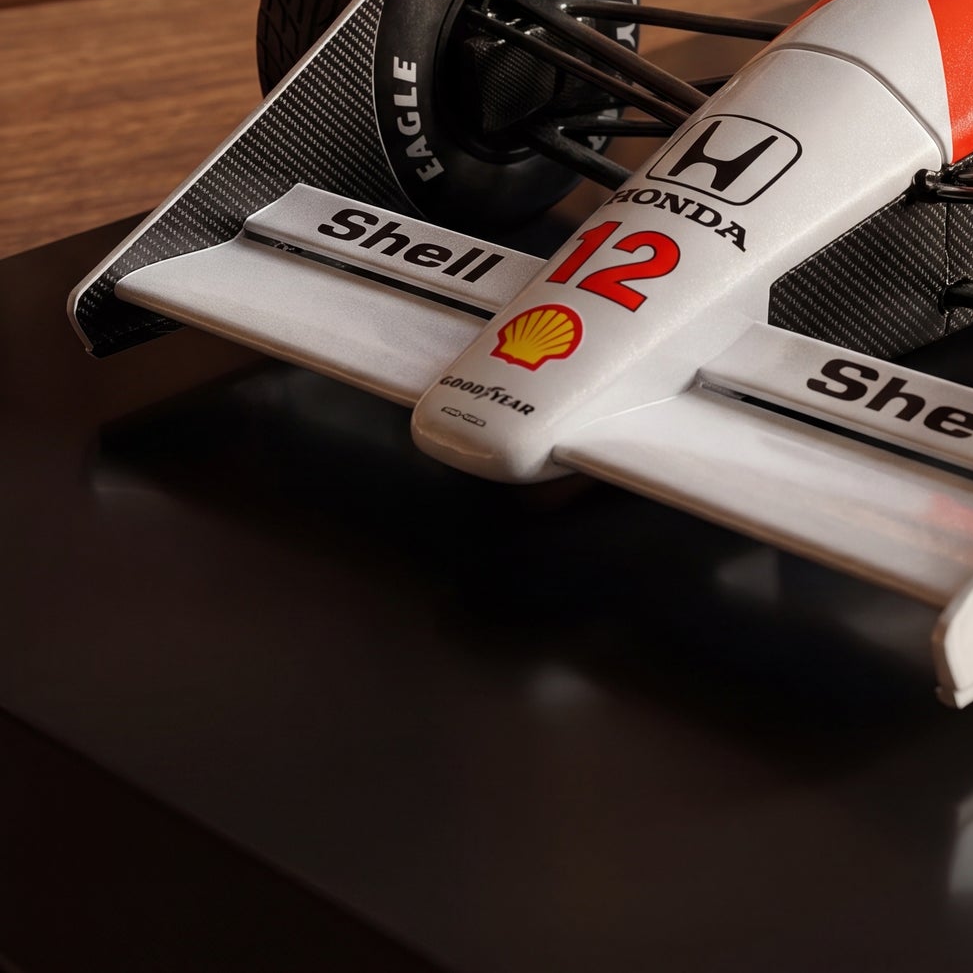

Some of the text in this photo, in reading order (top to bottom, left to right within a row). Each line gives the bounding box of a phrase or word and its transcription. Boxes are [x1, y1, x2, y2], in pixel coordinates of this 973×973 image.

[393, 56, 445, 182] EAGLE
[317, 208, 505, 283] Shell
[604, 188, 747, 253] HONDA
[545, 220, 681, 313] 12
[440, 375, 535, 416] GOODYEAR
